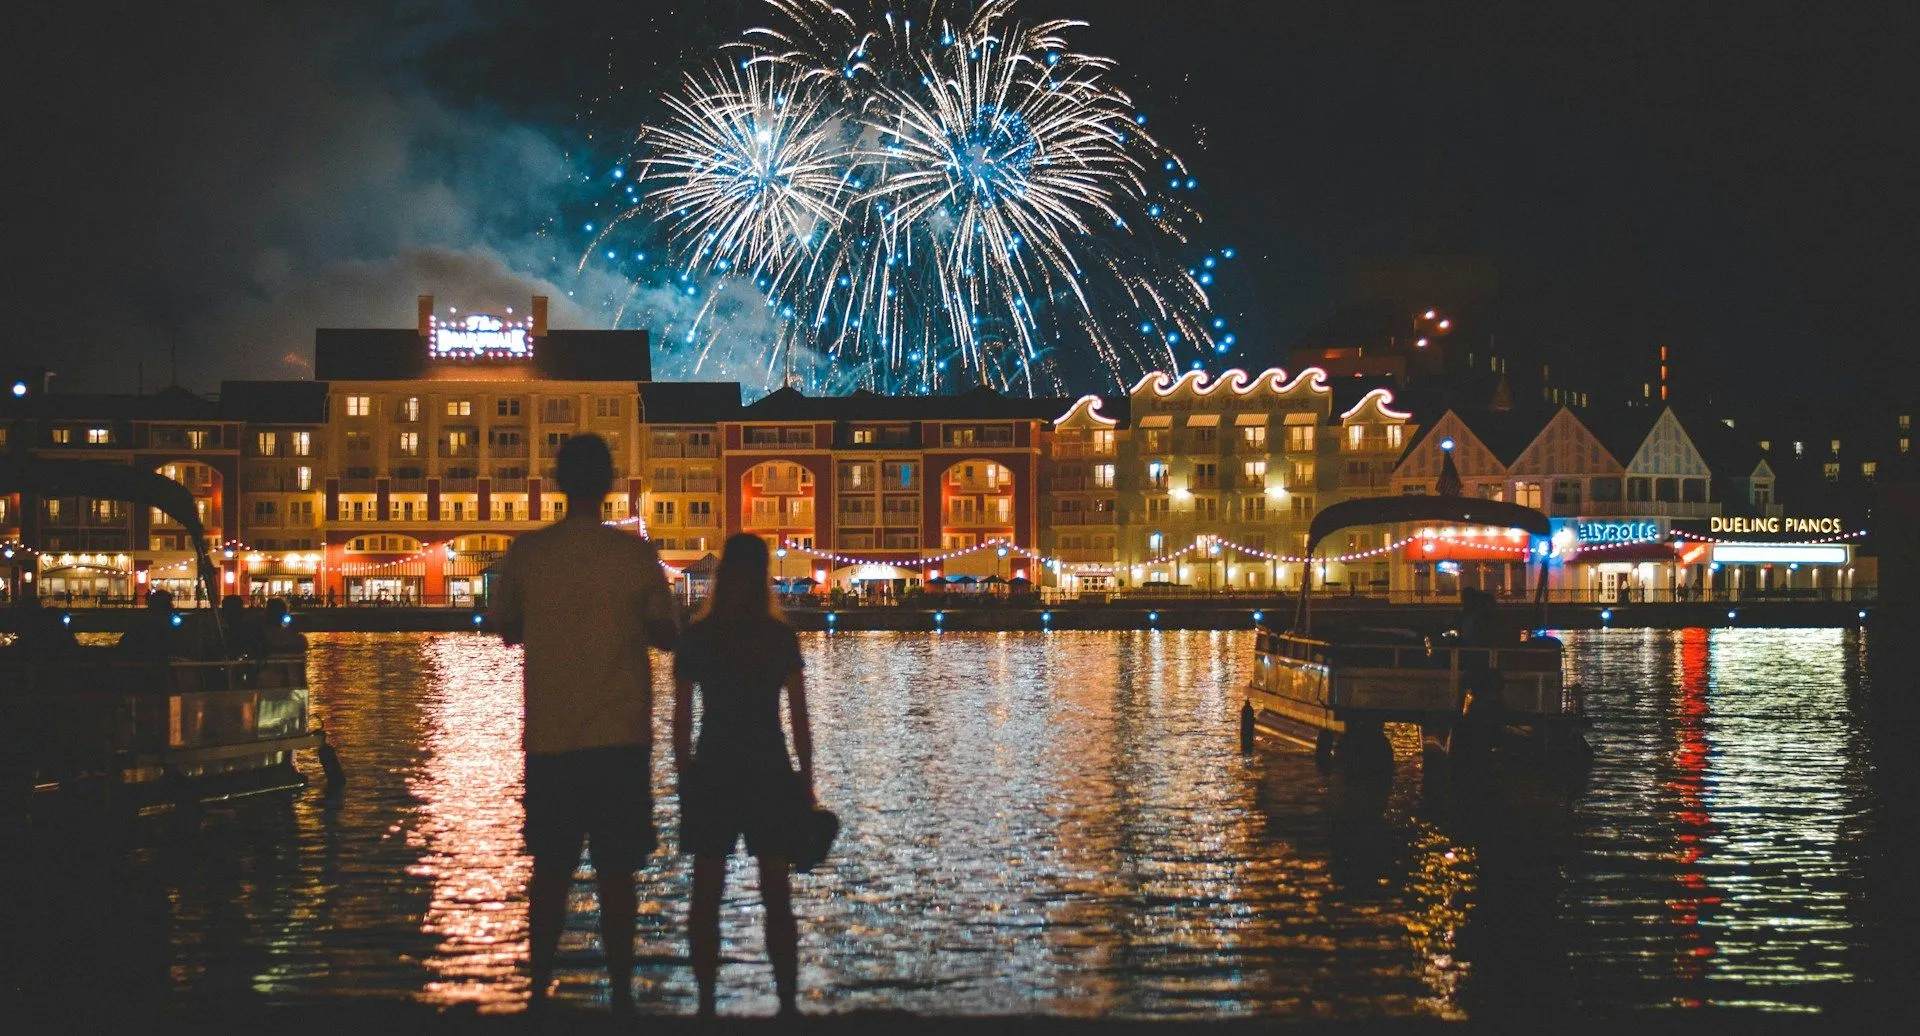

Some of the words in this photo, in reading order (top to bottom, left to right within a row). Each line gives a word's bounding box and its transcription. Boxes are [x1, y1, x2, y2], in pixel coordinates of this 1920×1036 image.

[1577, 523, 1657, 541] ELLYROLLS
[1711, 517, 1779, 533] DUELING
[1785, 517, 1841, 534] PIANOS
